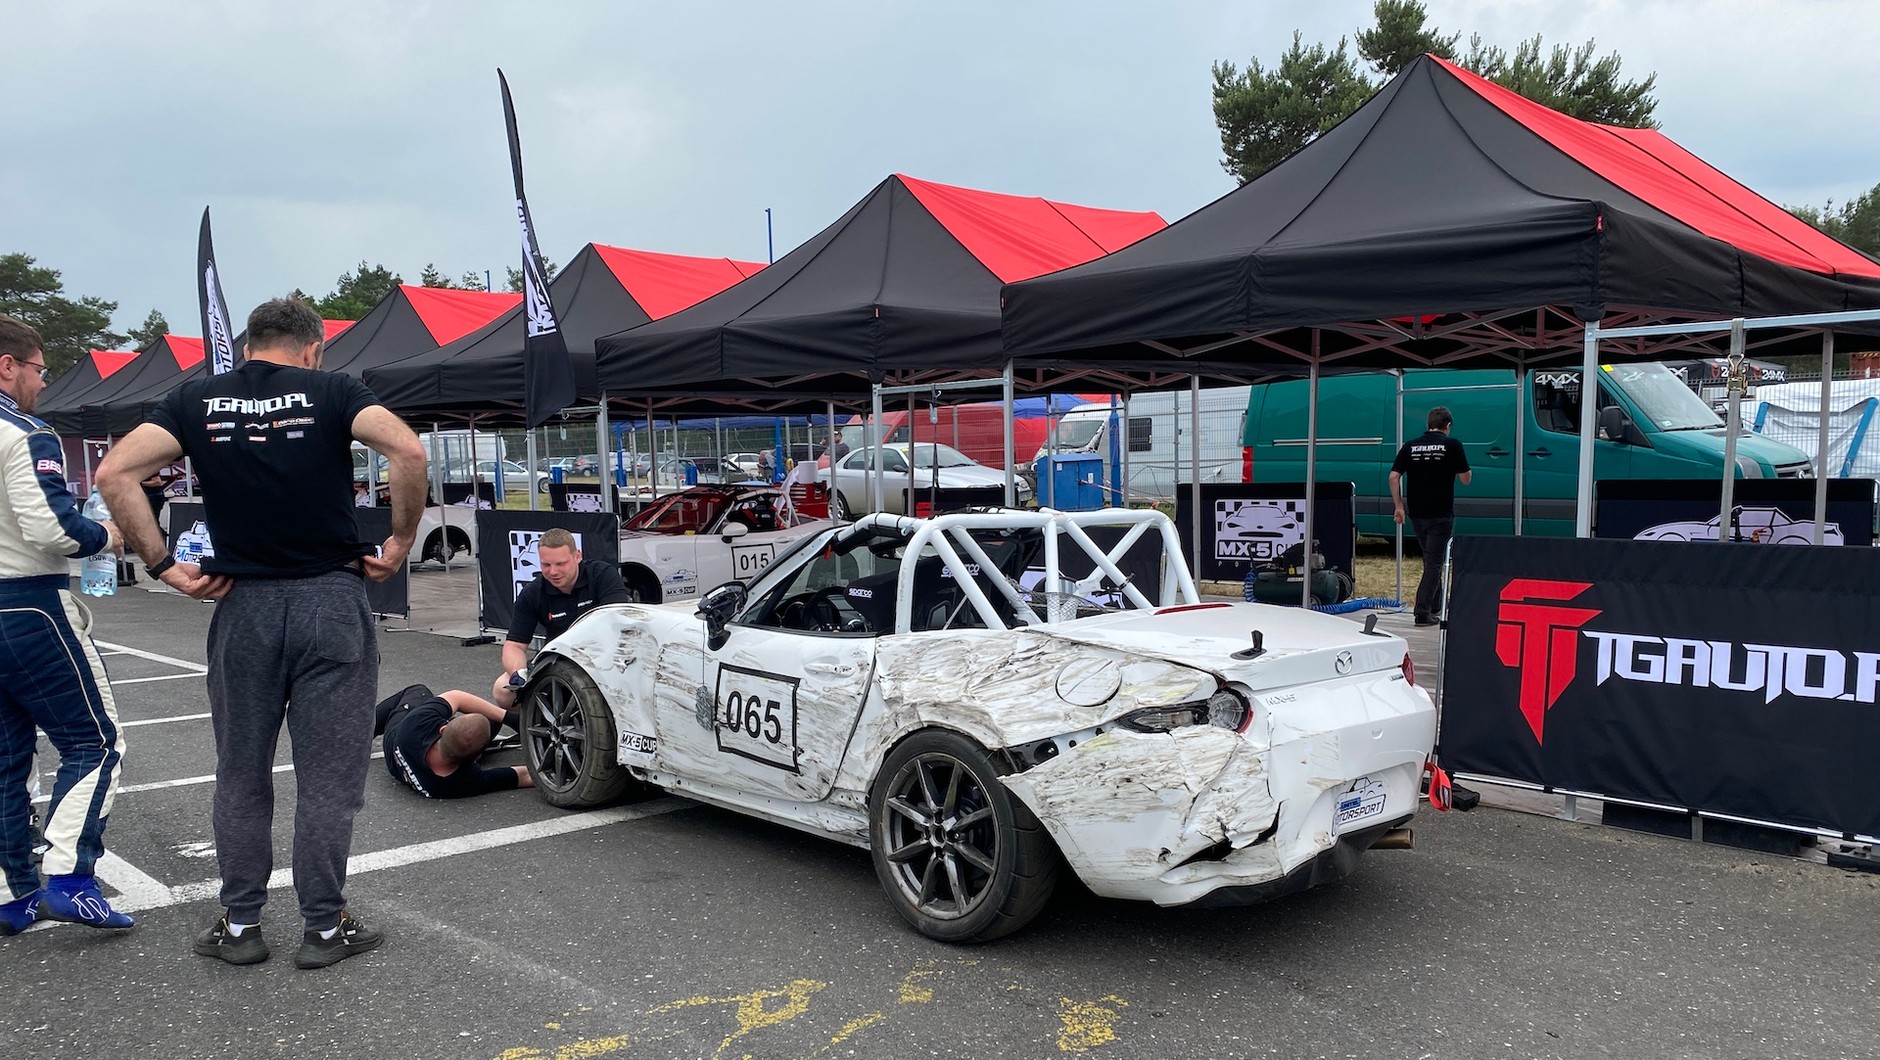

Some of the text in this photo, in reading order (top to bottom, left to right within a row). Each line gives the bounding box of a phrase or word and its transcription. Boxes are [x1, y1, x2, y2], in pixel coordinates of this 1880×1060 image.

[1762, 369, 1786, 382] 24MX
[202, 392, 314, 417] TGAUTO.PL
[37, 459, 62, 475] BBS
[1218, 541, 1271, 557] MX-5
[740, 552, 769, 571] 015
[848, 587, 873, 598] sparco
[726, 690, 782, 744] 065
[621, 731, 641, 748] MX-5
